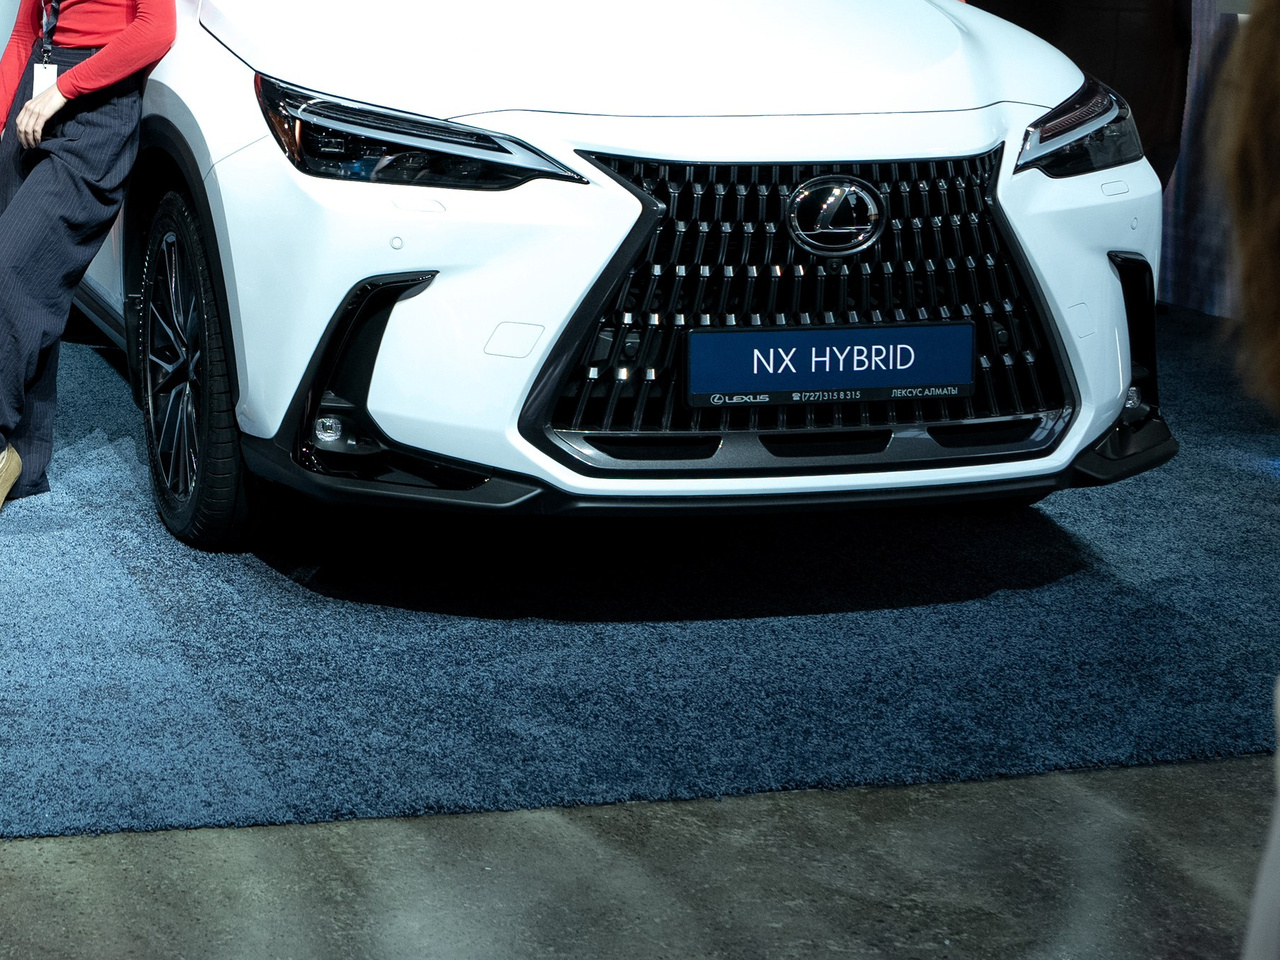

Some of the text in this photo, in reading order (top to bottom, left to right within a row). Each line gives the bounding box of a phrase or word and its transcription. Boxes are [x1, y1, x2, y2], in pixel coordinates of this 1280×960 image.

[753, 344, 915, 374] NX HYBRID
[891, 386, 958, 397] ЛЕКСУС АЛМАТЫ
[725, 394, 769, 403] LEXUS
